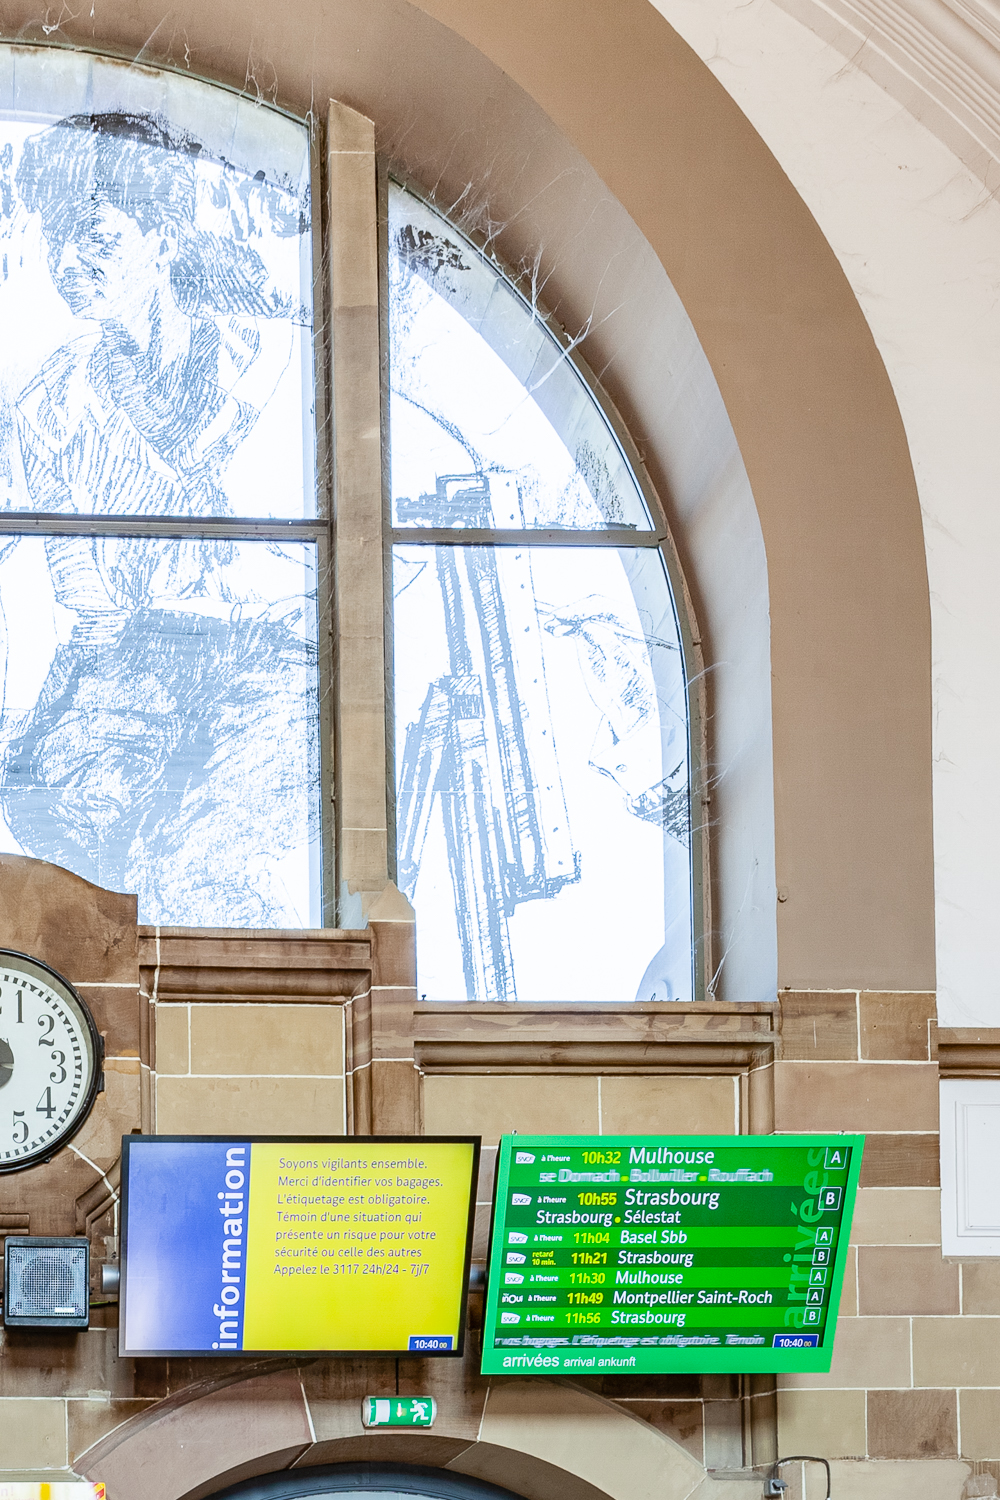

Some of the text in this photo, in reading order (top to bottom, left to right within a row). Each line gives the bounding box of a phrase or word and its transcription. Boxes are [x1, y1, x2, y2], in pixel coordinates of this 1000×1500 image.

[15, 990, 24, 1023] 1
[38, 1014, 55, 1046] 2
[50, 1050, 66, 1084] 3
[36, 1087, 56, 1119] 4
[13, 1110, 29, 1143] 5
[582, 1148, 841, 1164] 10h32 Mulhouse A
[279, 1158, 427, 1171] Soyons vigilants ensemble.
[278, 1176, 443, 1189] Merci d'identifier vos bagages.
[277, 1194, 430, 1207] L'étiquetage est obligatoire.
[577, 1189, 835, 1209] 10h55 Strasbourg B
[277, 1212, 422, 1224] Témoin d'une situation qui
[536, 1210, 681, 1227] Strasbourg Sélestat
[276, 1230, 436, 1242] présente un risque pour votre
[574, 1232, 610, 1244] 11h04
[620, 1230, 657, 1244] Basel
[661, 1231, 687, 1244] Sbb
[783, 1147, 828, 1328] arrivées
[212, 1147, 246, 1349] information
[275, 1247, 422, 1257] sécurité ou celle des autres
[572, 1252, 607, 1264] 11h21
[618, 1251, 693, 1267] Strasbourg
[274, 1264, 429, 1276] Appelez le 3117 24h/24 7j/7
[569, 1272, 605, 1284] 11h30
[616, 1271, 683, 1284] Mulhouse
[567, 1292, 603, 1304] 11h49
[613, 1291, 694, 1307] Montpellier
[697, 1291, 772, 1304] Saint-Roch
[565, 1312, 601, 1323] 11h56
[611, 1311, 686, 1327] Strasbourg
[414, 1340, 438, 1348] 10:40
[779, 1339, 802, 1347] 10:40
[503, 1354, 636, 1367] arrivées arrival ankunft
